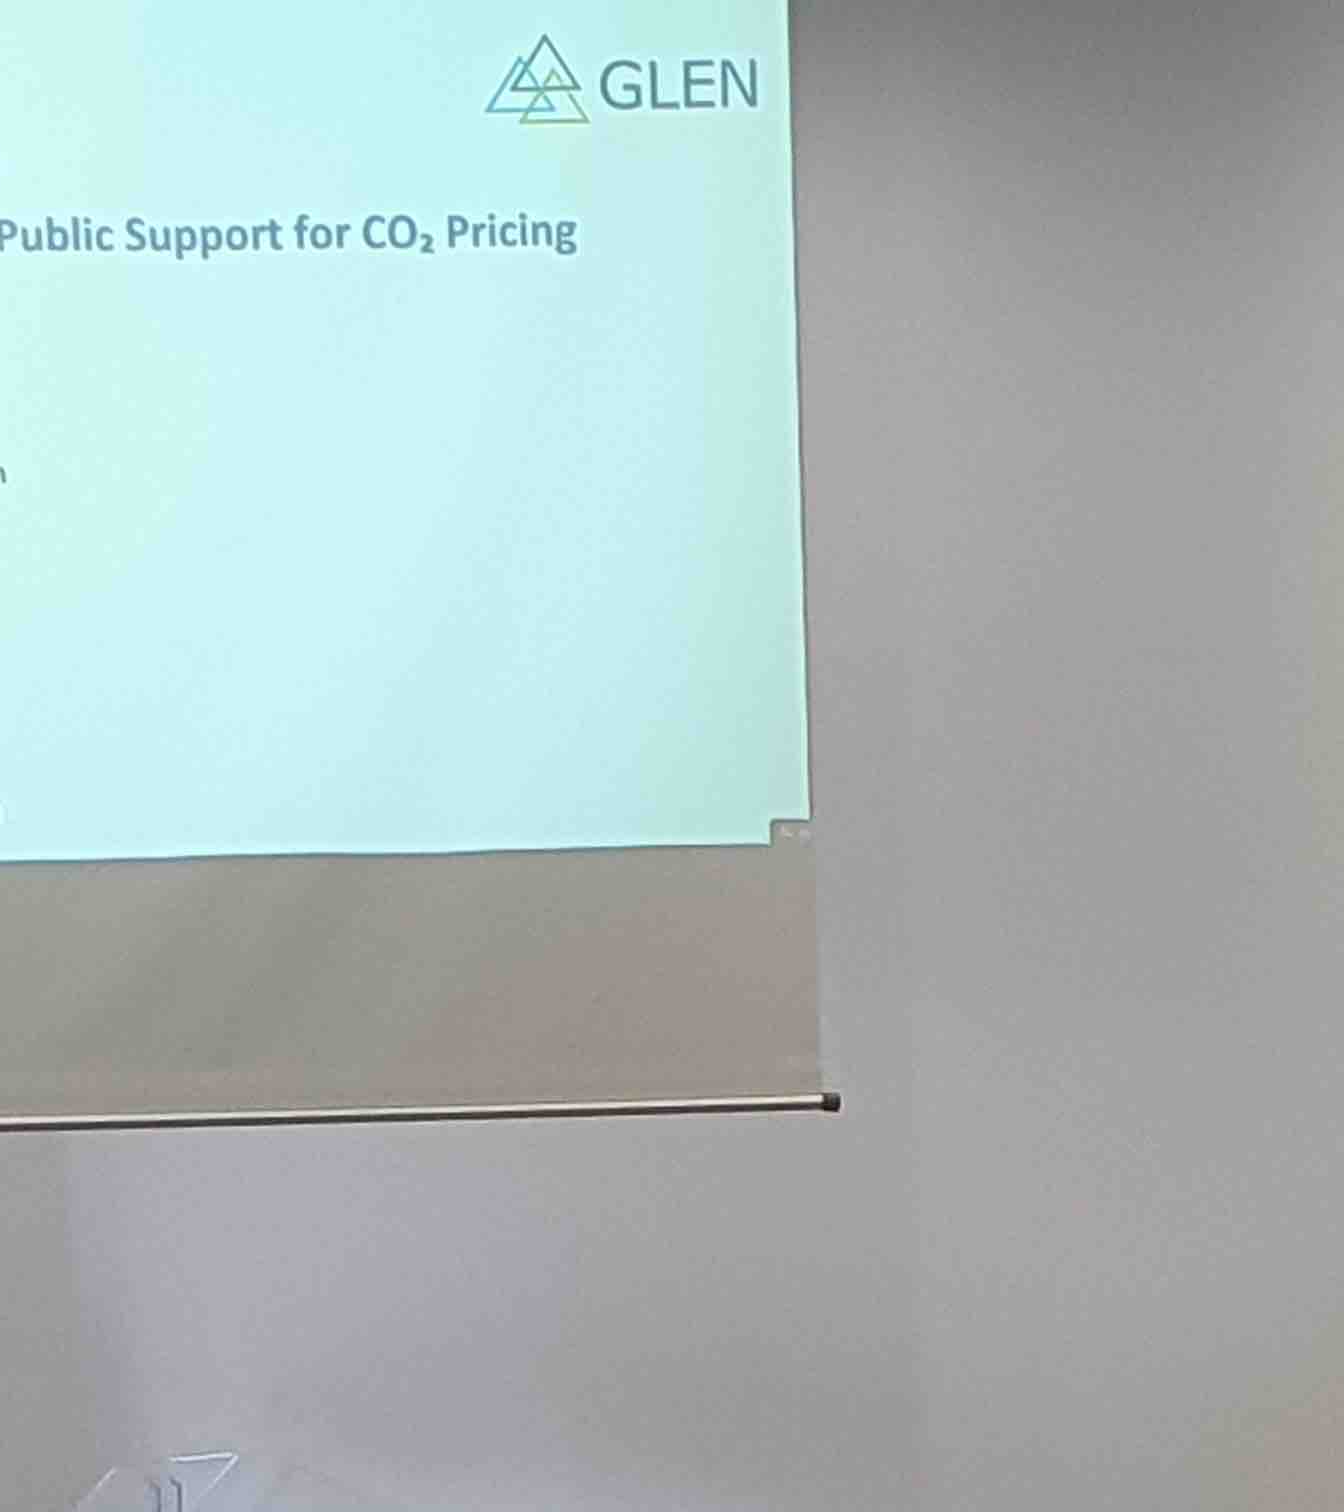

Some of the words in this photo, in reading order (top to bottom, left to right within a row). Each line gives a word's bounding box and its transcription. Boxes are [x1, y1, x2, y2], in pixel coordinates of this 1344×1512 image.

[599, 58, 759, 110] GLEN
[125, 216, 284, 261] Support
[293, 213, 352, 250] for
[447, 212, 577, 256] Pricing
